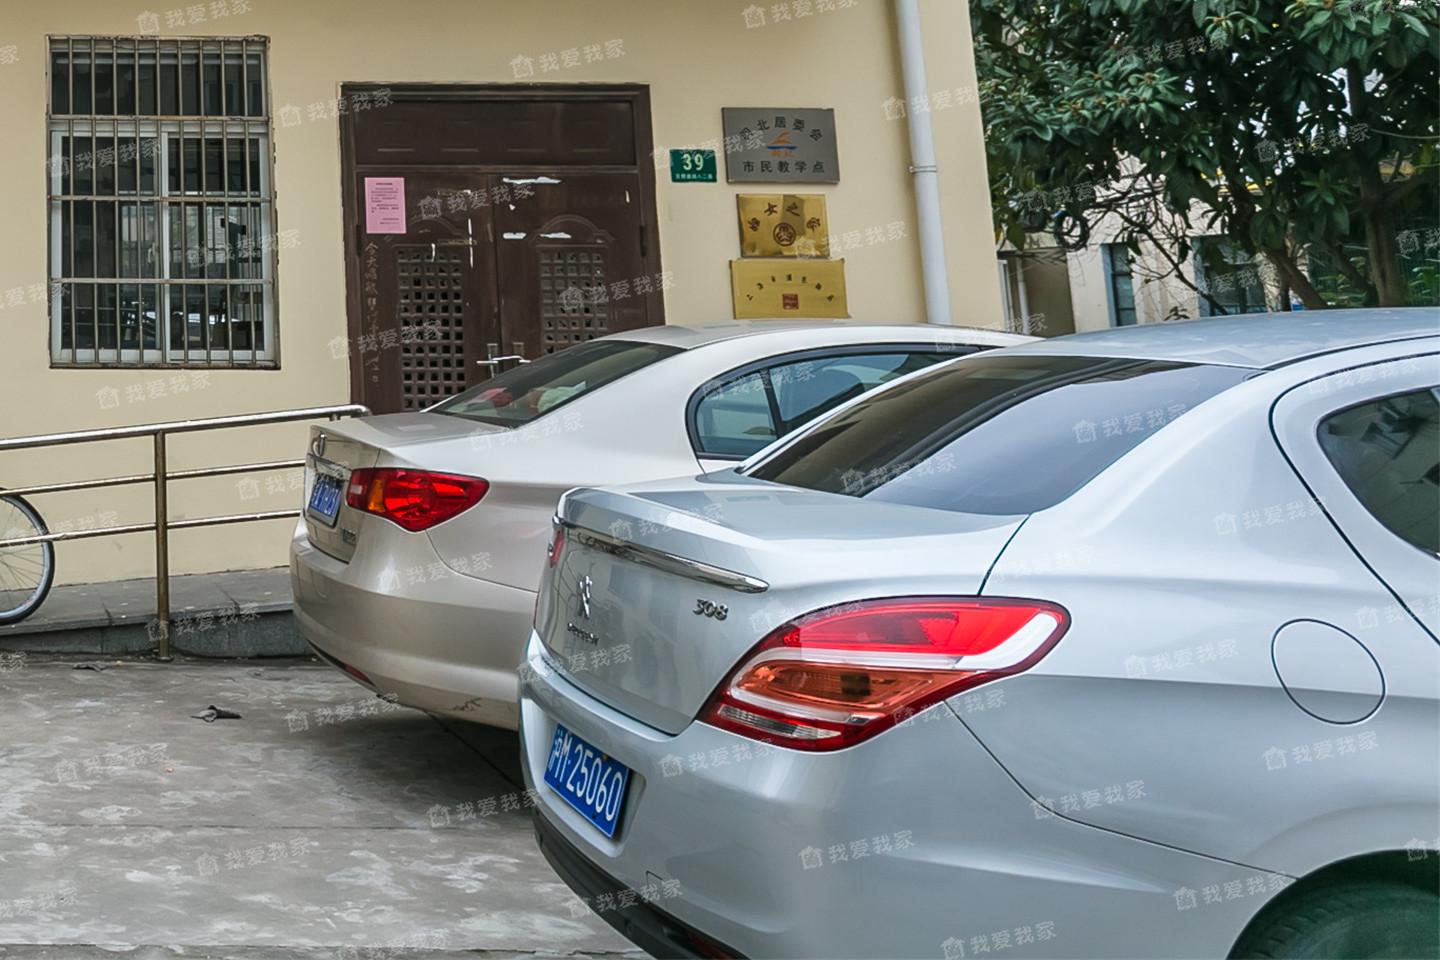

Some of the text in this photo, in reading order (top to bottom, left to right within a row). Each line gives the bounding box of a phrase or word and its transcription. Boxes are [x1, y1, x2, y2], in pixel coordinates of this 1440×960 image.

[682, 153, 704, 171] 39
[742, 160, 825, 174] 市民教学点
[692, 599, 729, 621] 308
